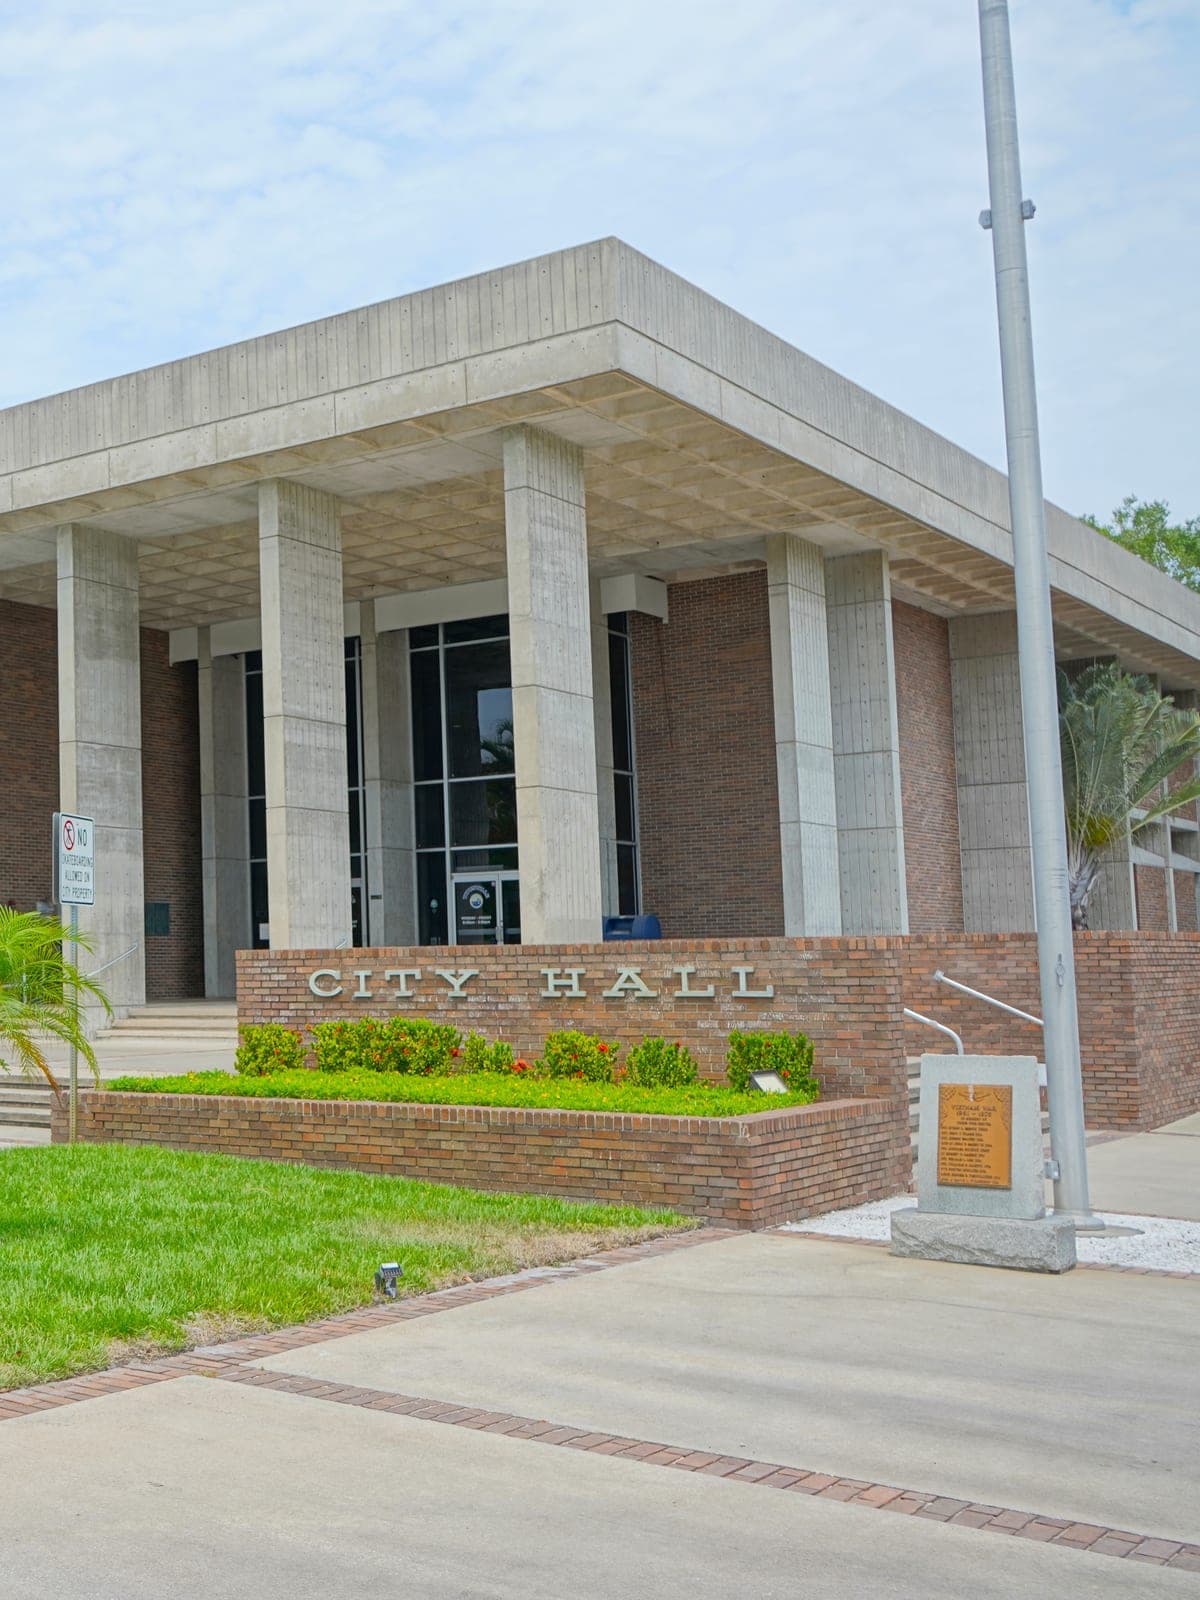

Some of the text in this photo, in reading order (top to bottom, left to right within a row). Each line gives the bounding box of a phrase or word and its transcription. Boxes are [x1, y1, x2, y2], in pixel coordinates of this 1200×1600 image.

[77, 828, 88, 847] NO
[65, 870, 90, 883] ALLOWED ON
[72, 887, 93, 899] PROPERTY
[308, 966, 775, 998] CITY HALL
